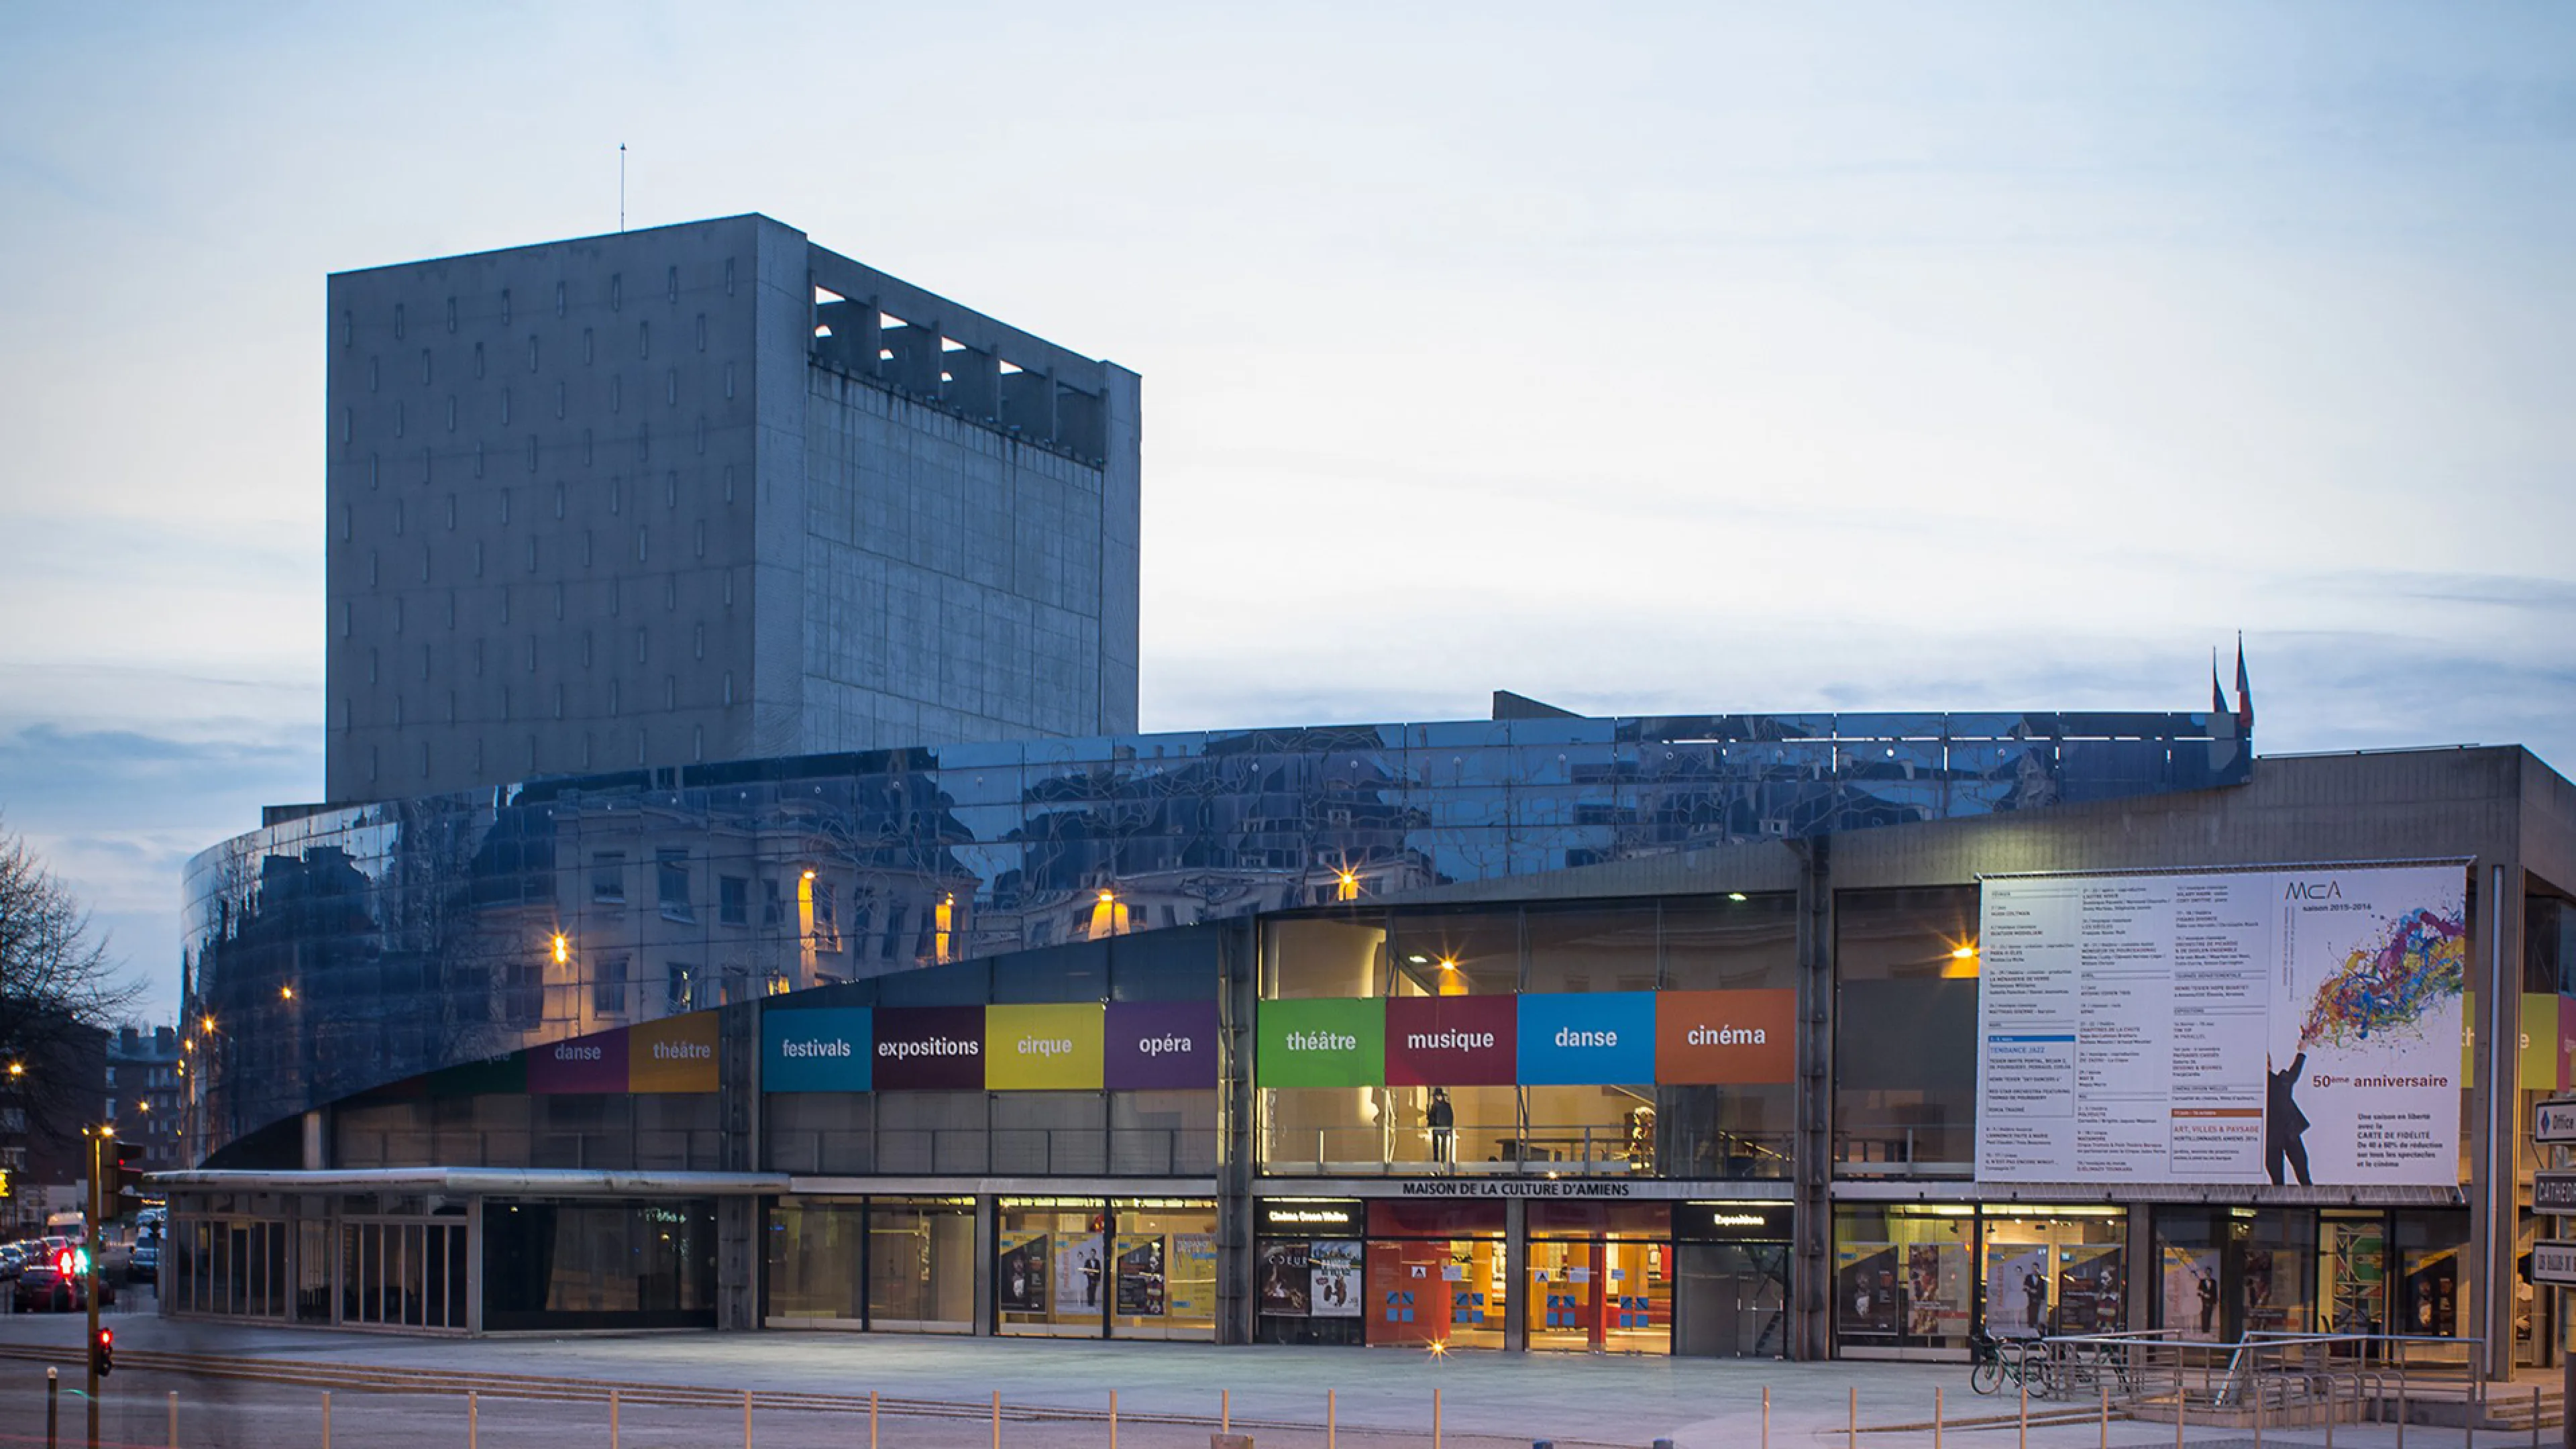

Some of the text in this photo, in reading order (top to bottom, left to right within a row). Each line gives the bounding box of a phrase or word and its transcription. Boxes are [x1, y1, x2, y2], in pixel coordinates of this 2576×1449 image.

[2285, 881, 2343, 900] MCA
[1286, 1030, 1356, 1051] théâtre
[1408, 1029, 1495, 1052] musique
[1555, 1026, 1617, 1047] danse
[1687, 1024, 1766, 1045] cinéma
[555, 1043, 602, 1060] danse
[653, 1040, 711, 1059] théâtre
[783, 1038, 851, 1057] festivals
[878, 1036, 979, 1060] expositions
[1018, 1035, 1073, 1057] cirque
[1139, 1033, 1192, 1057] opéra
[2354, 1073, 2448, 1087] anniversaire
[2357, 1130, 2430, 1140] CARTE DE FIDÉLITÉ
[2357, 1141, 2367, 1149] De
[2400, 1141, 2408, 1149] de
[2409, 1141, 2444, 1149] réduction
[2365, 1160, 2372, 1168] le
[2398, 1151, 2436, 1160] spectacles
[1403, 1183, 1629, 1196] MAISON DE LA CULTURE D'AMIENS
